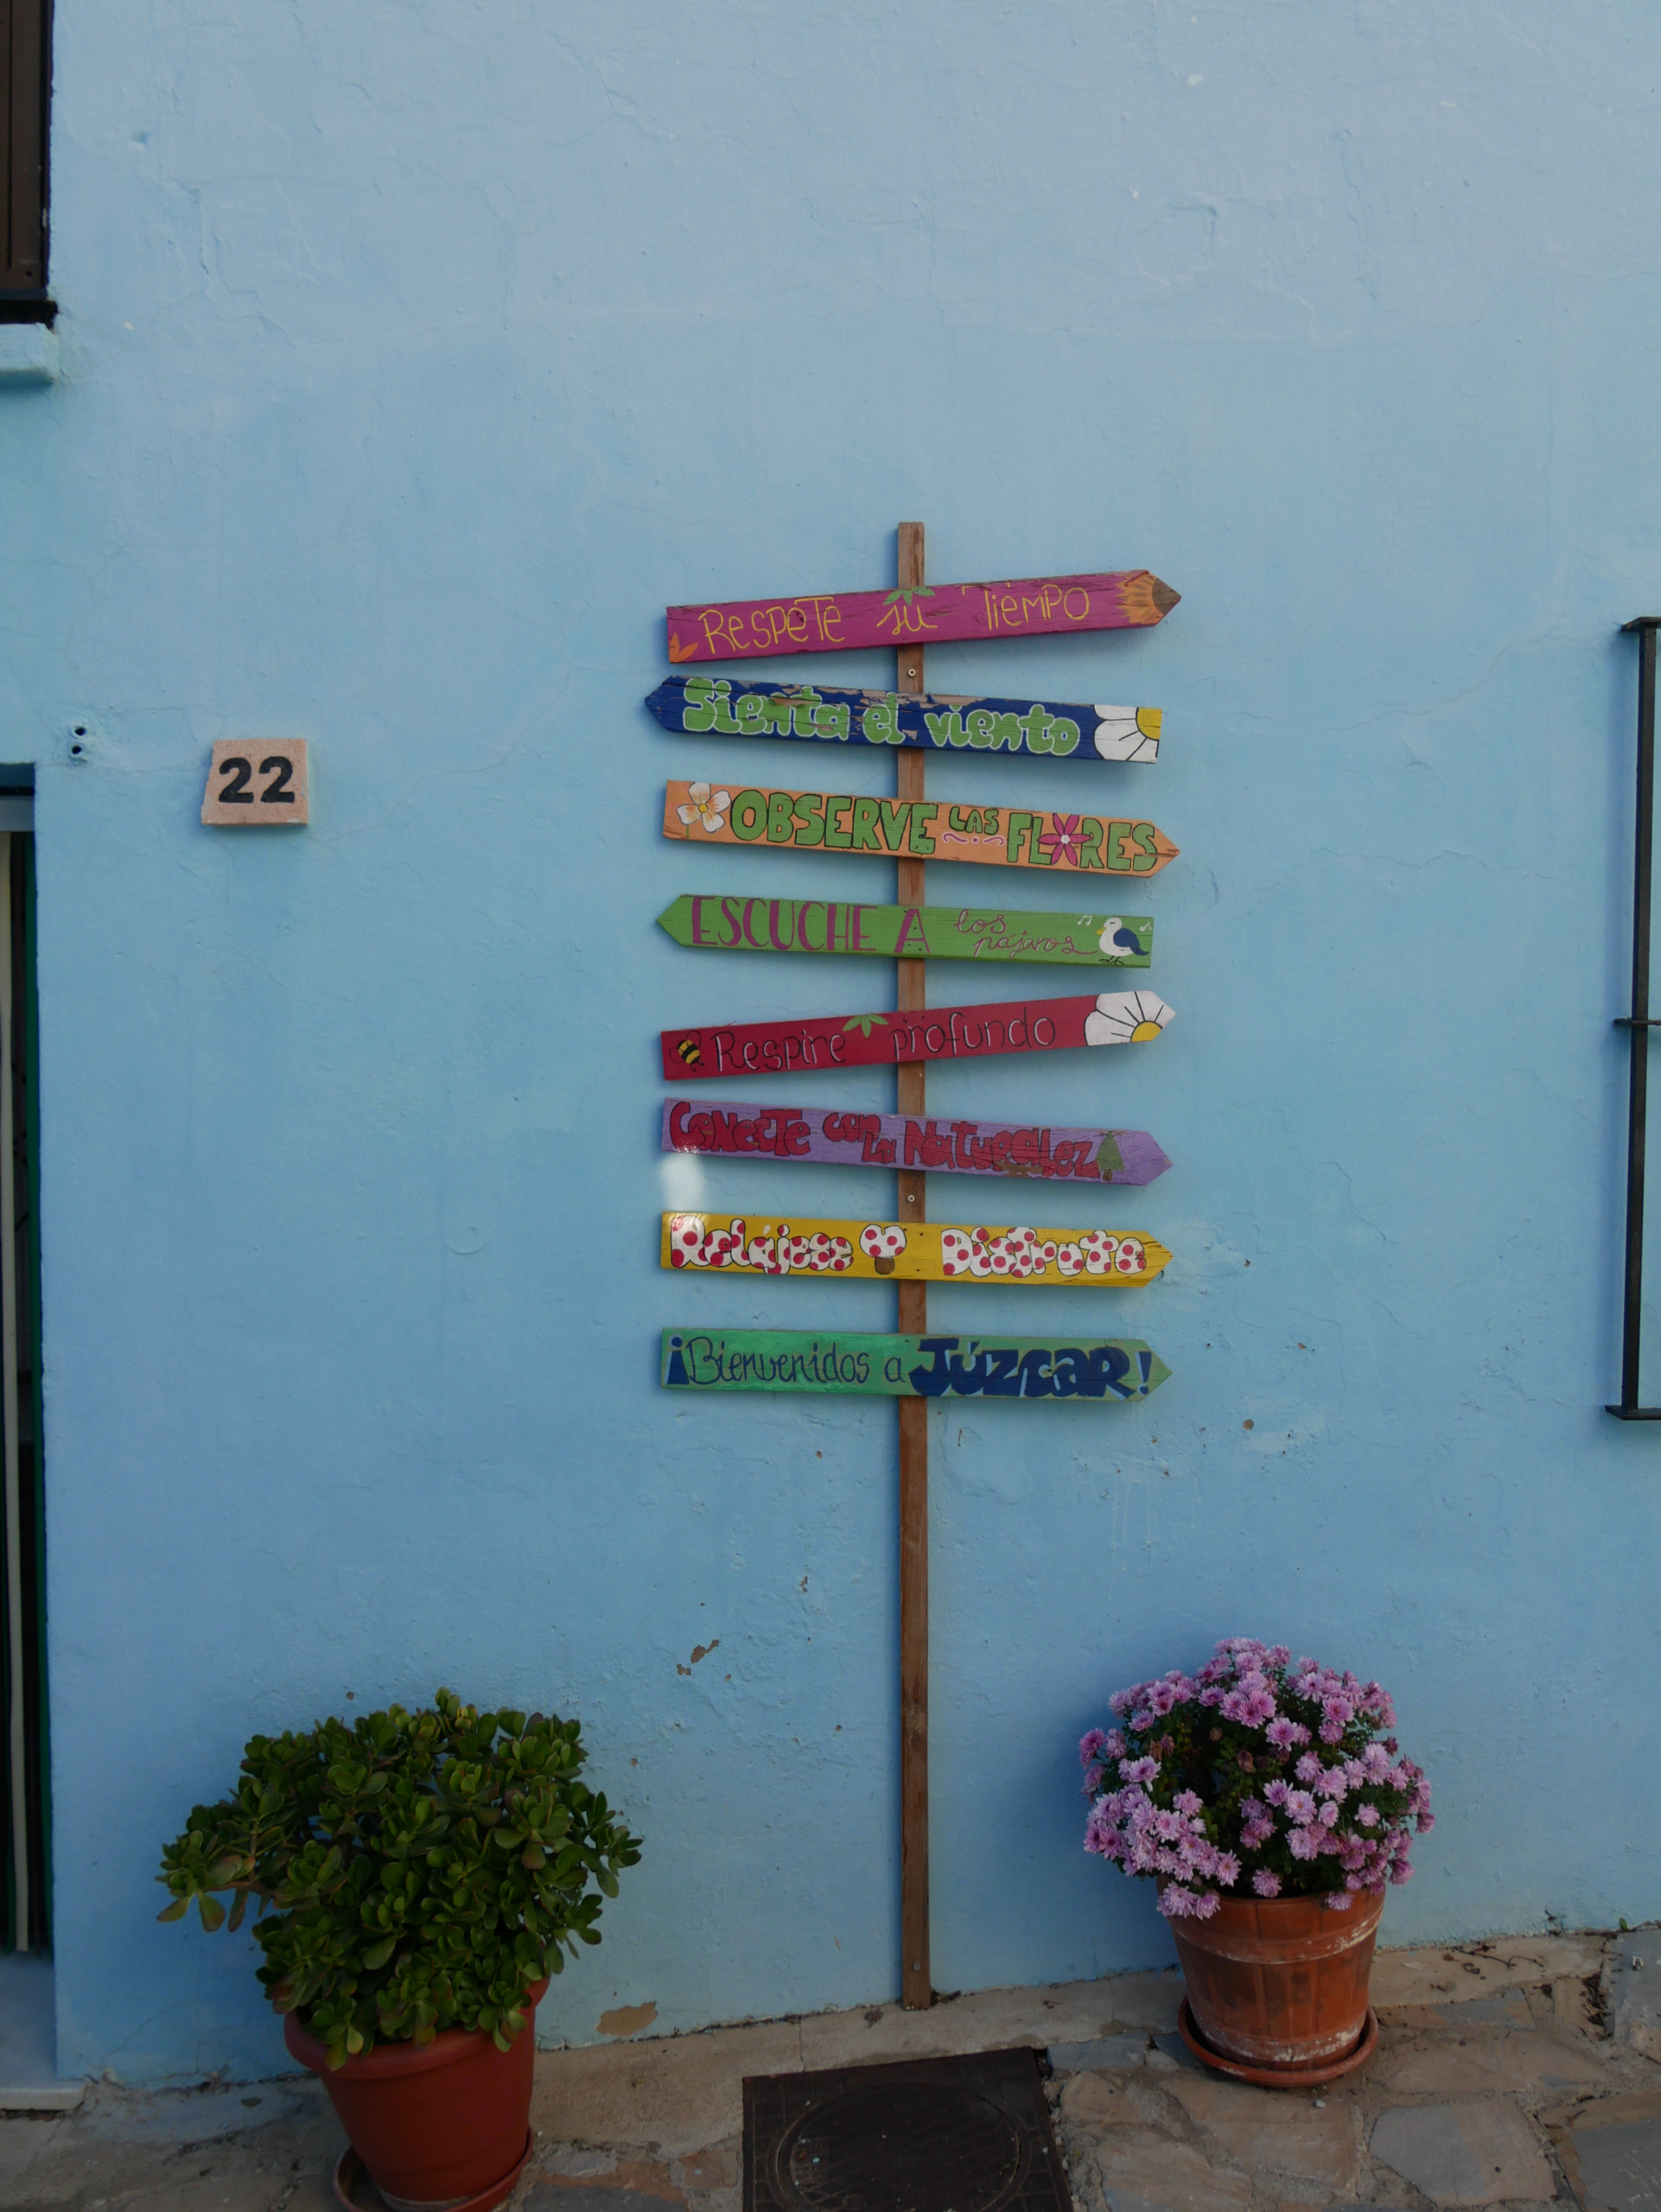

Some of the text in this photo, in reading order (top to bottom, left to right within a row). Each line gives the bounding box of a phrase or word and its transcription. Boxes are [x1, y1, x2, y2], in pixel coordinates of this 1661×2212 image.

[683, 677, 1080, 756] Sienta el viento
[219, 756, 296, 803] 22
[730, 790, 1158, 871] OBSERVE LAS FLORES
[692, 896, 1006, 954] ESCUCHE A los
[973, 931, 1098, 958] pájaros
[710, 1007, 1055, 1071] Respire profundo
[823, 1112, 881, 1142] con
[671, 1215, 853, 1274] Relájese
[941, 1227, 1146, 1278] Disfrute
[665, 1333, 869, 1385] ¡Bienvenidos
[883, 1357, 906, 1383] a
